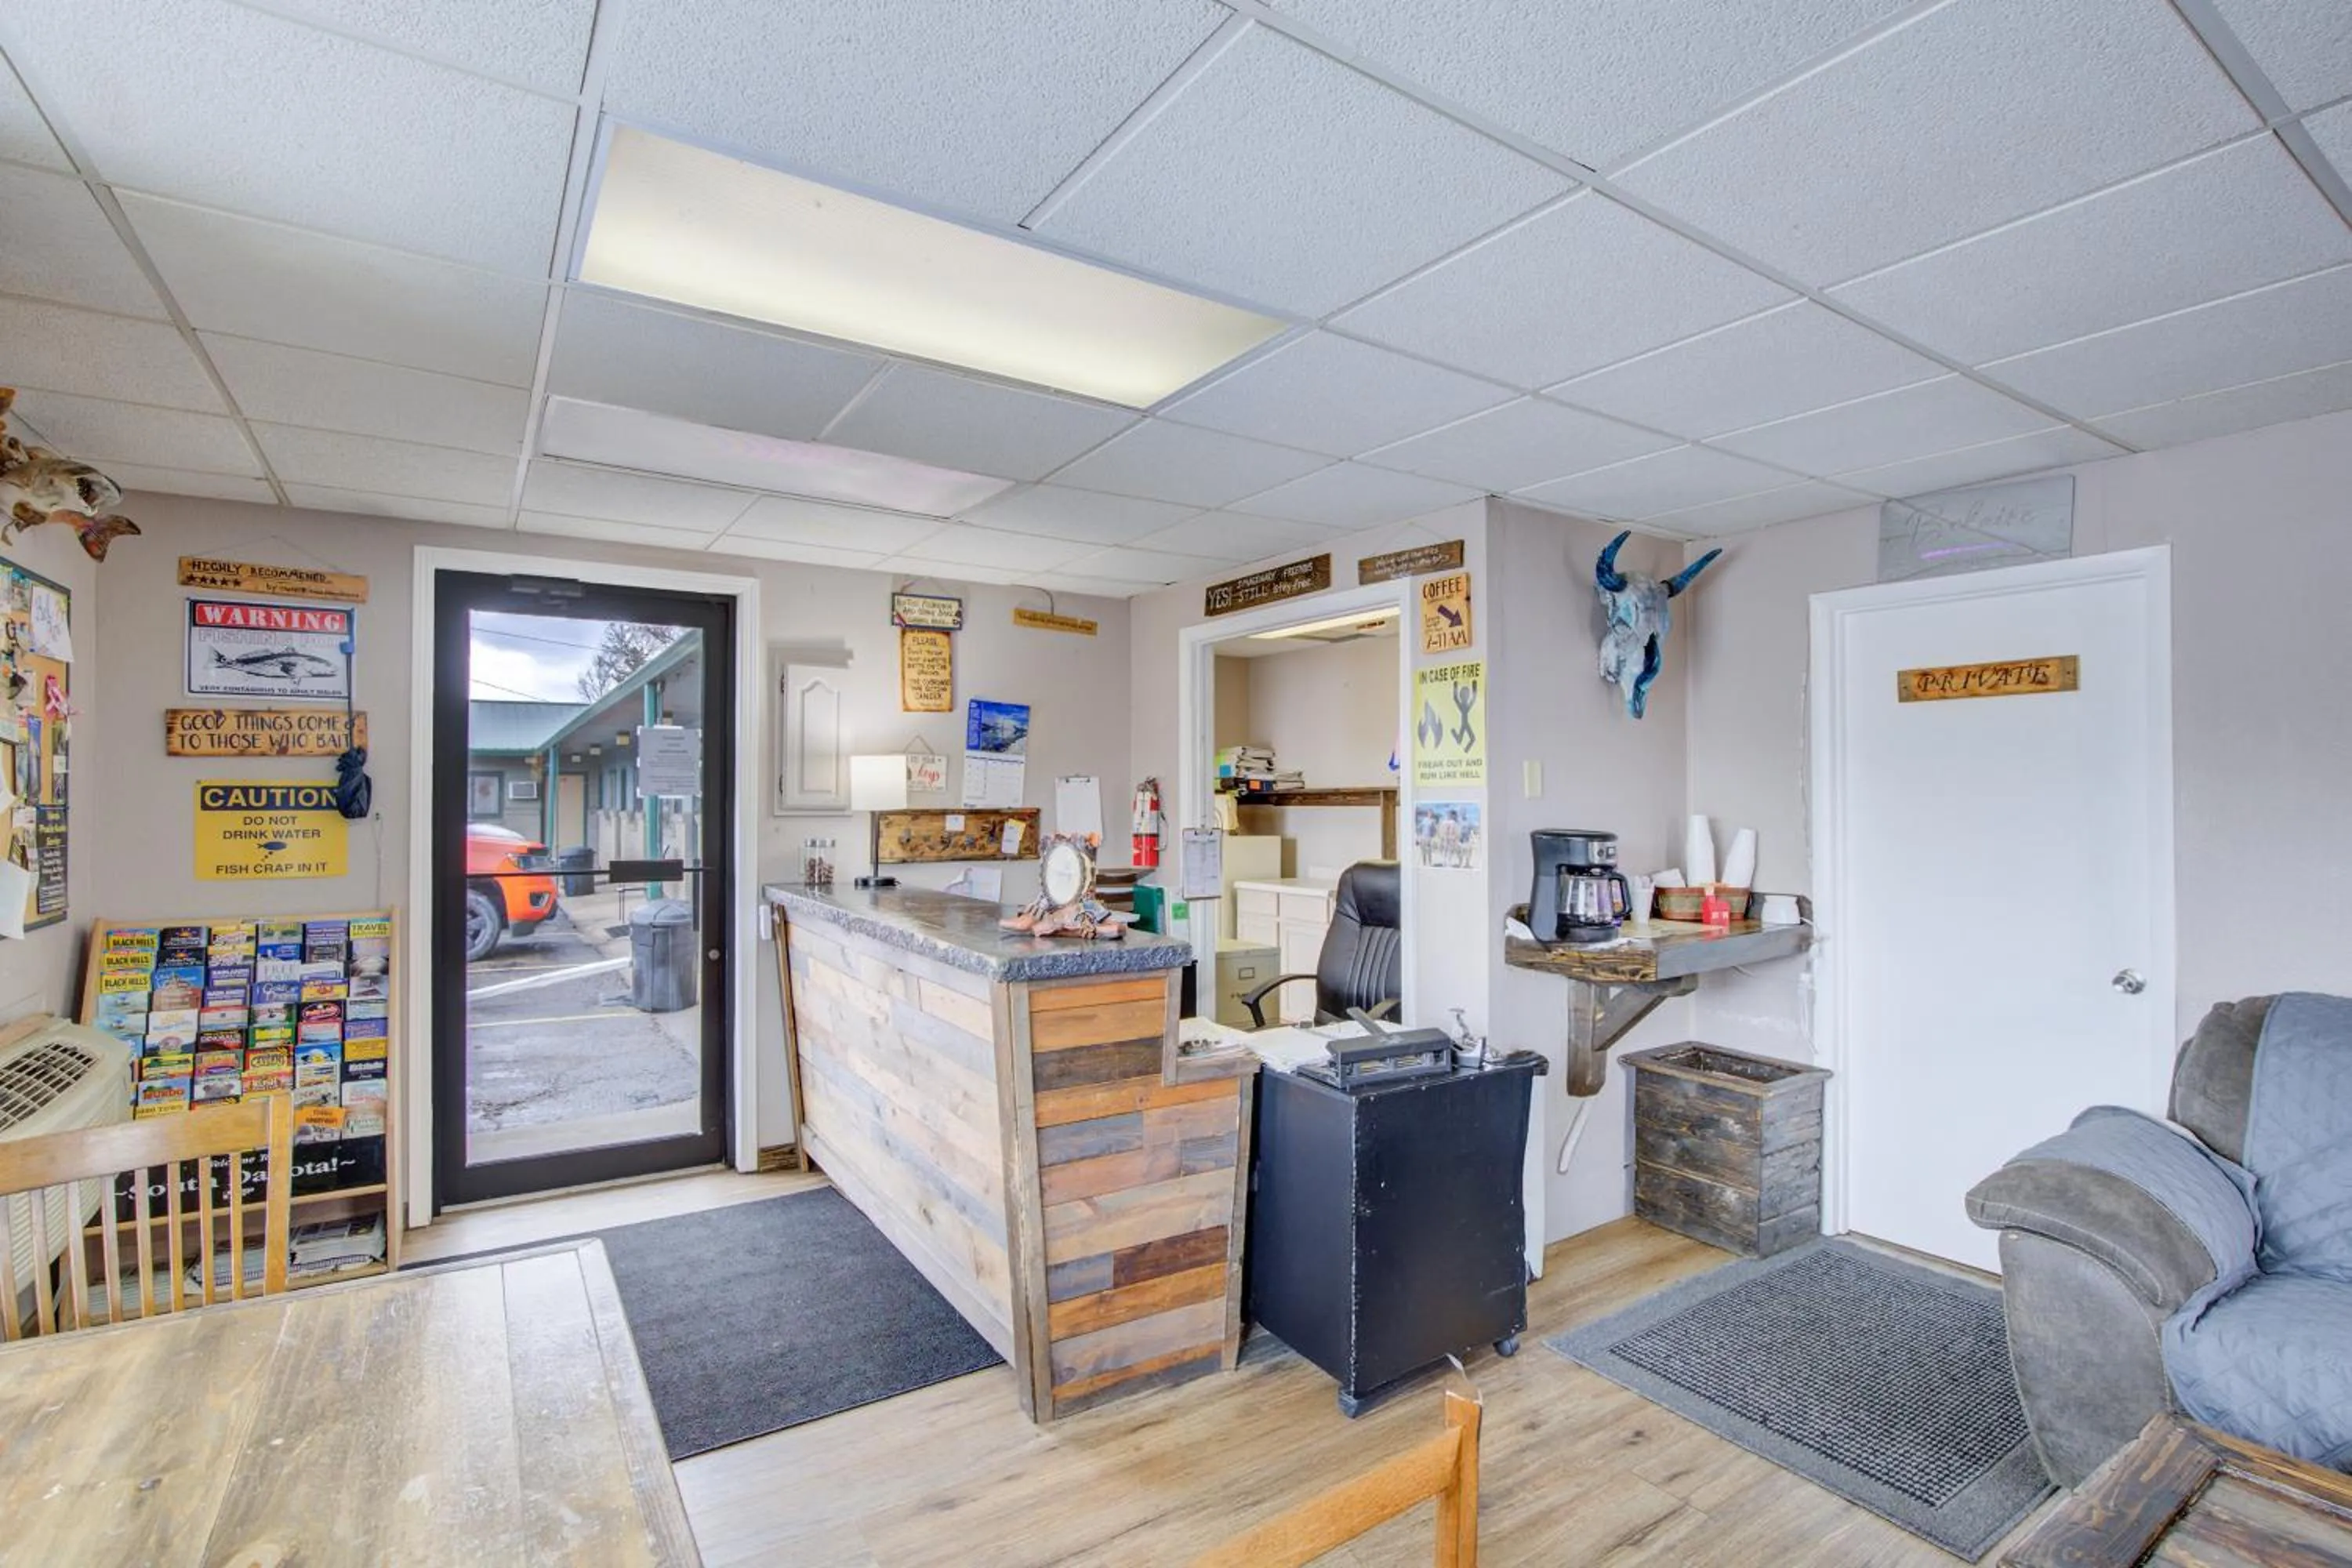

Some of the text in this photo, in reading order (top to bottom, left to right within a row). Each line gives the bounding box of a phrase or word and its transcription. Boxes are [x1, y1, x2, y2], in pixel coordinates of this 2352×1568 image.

[192, 561, 241, 575] HIGHLY
[1423, 576, 1462, 599] COFFEE
[204, 606, 340, 630] WARNING
[1419, 662, 1481, 684] IN CASE OF FIRE
[1917, 662, 2050, 692] PRIVATE
[234, 714, 292, 732] THINGS
[297, 714, 340, 731] COME
[179, 732, 350, 750] TO THOSE WHO BAIT
[1466, 758, 1483, 767] AND
[1420, 769, 1480, 780] RUN LIKE HELL
[205, 788, 337, 807] CAUTION
[269, 816, 297, 825] NOT
[223, 829, 321, 839] DRINK WATER
[216, 865, 248, 873] FISH
[254, 864, 293, 873] CRAP
[315, 862, 327, 871] IT
[238, 1157, 356, 1185] aota!~
